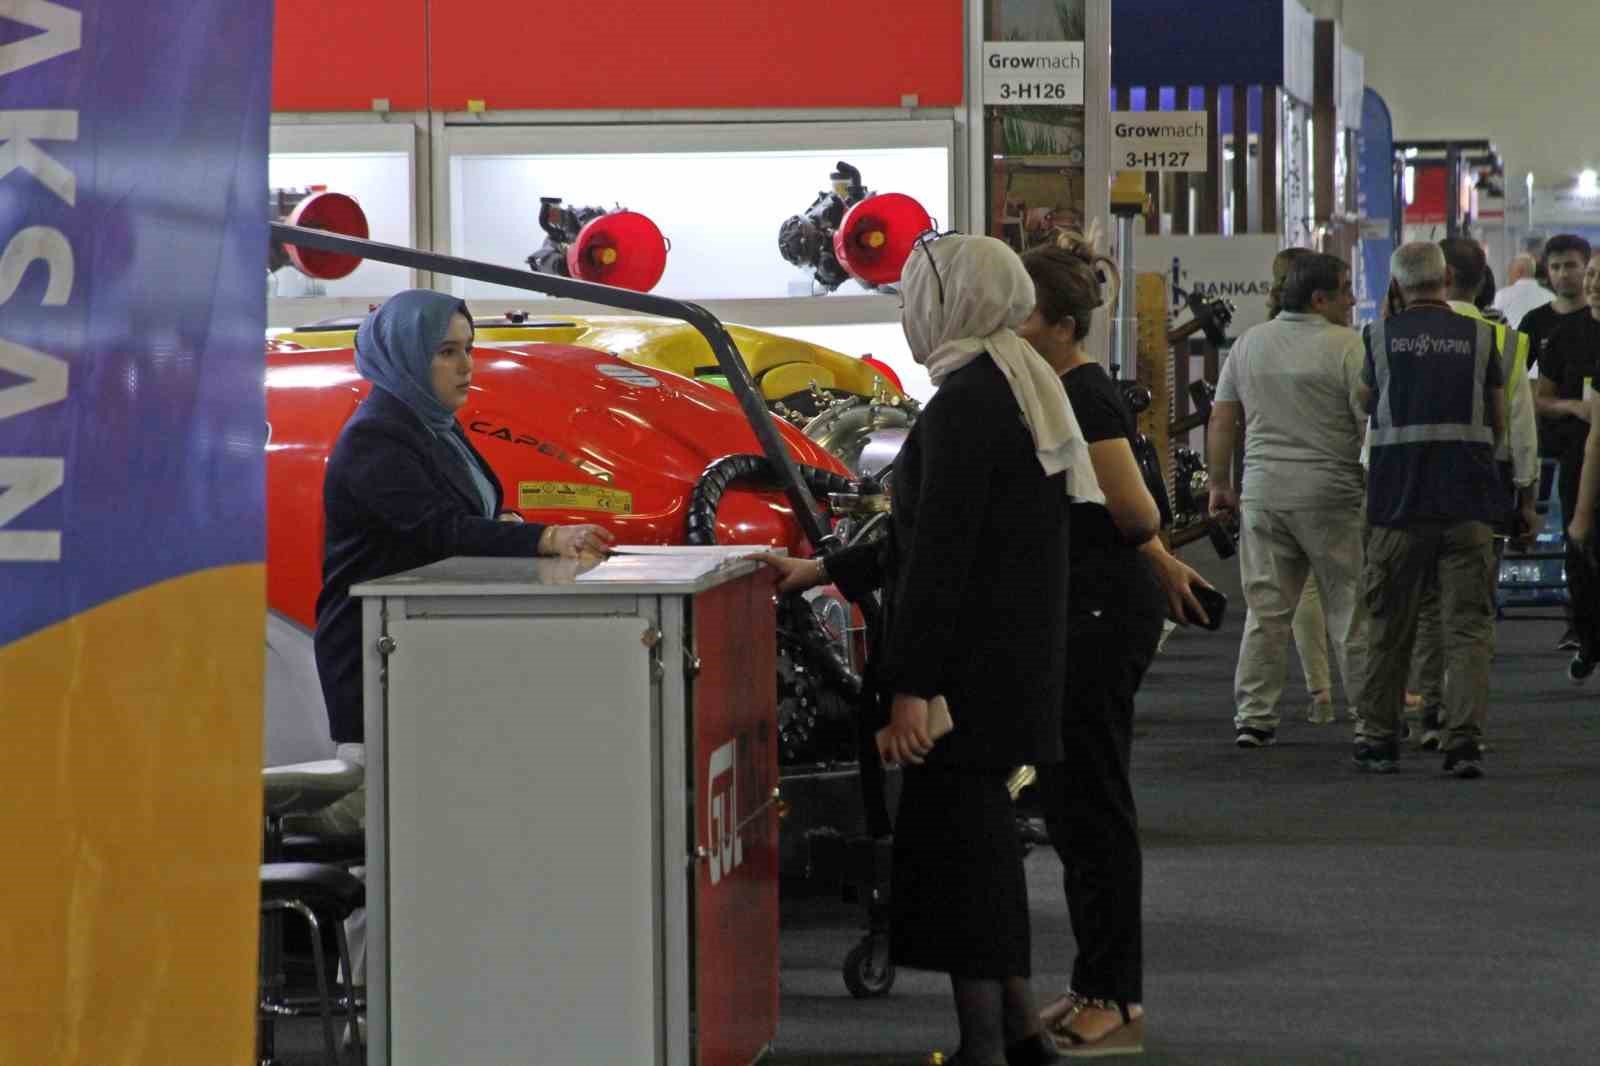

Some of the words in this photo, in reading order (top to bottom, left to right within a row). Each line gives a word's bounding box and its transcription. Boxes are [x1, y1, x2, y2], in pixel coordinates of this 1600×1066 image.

[988, 53, 1080, 69] Growmach
[1000, 84, 1066, 99] 3-H126
[1115, 122, 1204, 138] Growmach
[1126, 152, 1190, 167] 3-H127
